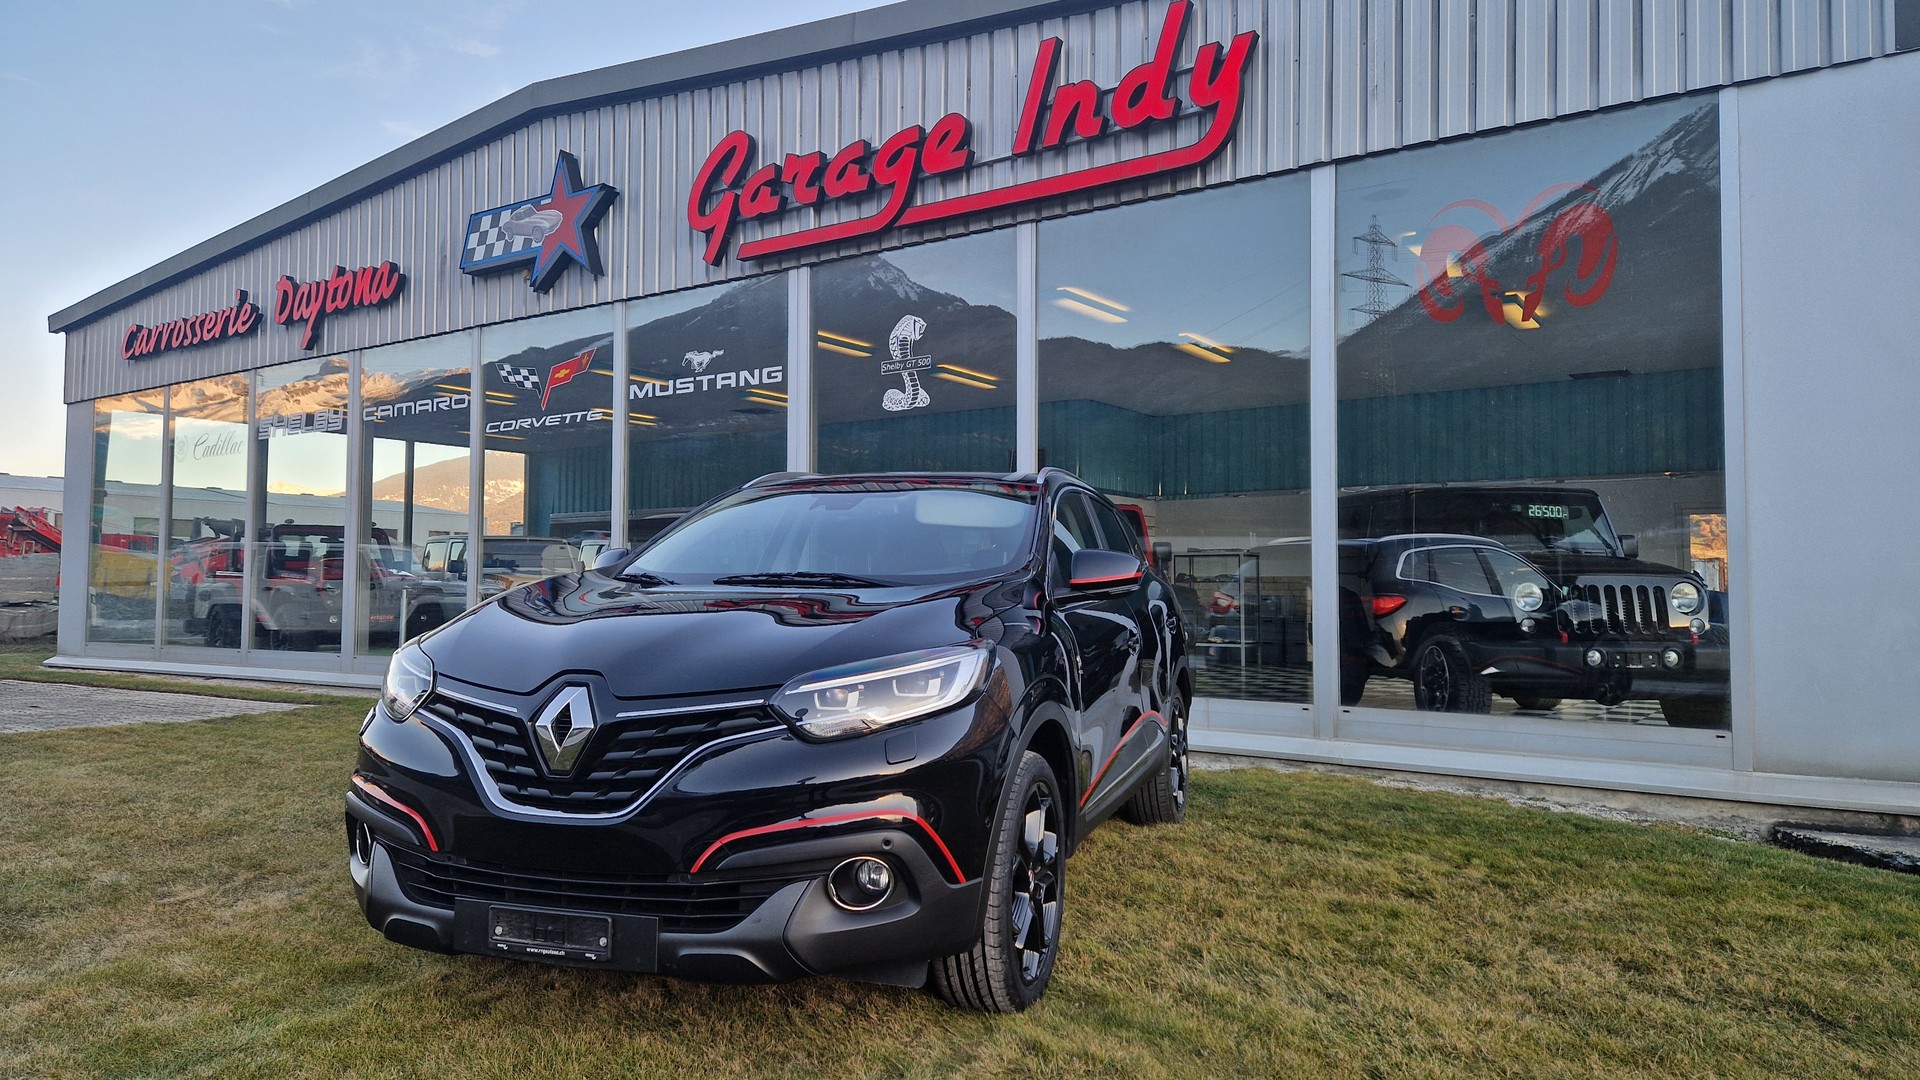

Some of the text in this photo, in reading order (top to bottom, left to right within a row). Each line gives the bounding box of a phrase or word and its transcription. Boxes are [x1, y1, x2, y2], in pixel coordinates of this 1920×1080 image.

[687, 0, 1260, 266] Garage Indy
[121, 260, 405, 360] Carrosserie Daytona
[882, 358, 930, 372] Shelby GT 500
[629, 365, 783, 400] MUSTANG
[258, 405, 344, 440] SHELBY
[362, 394, 469, 422] CAMARO
[485, 410, 603, 434] CORVETTE
[193, 430, 244, 460] Cadillac
